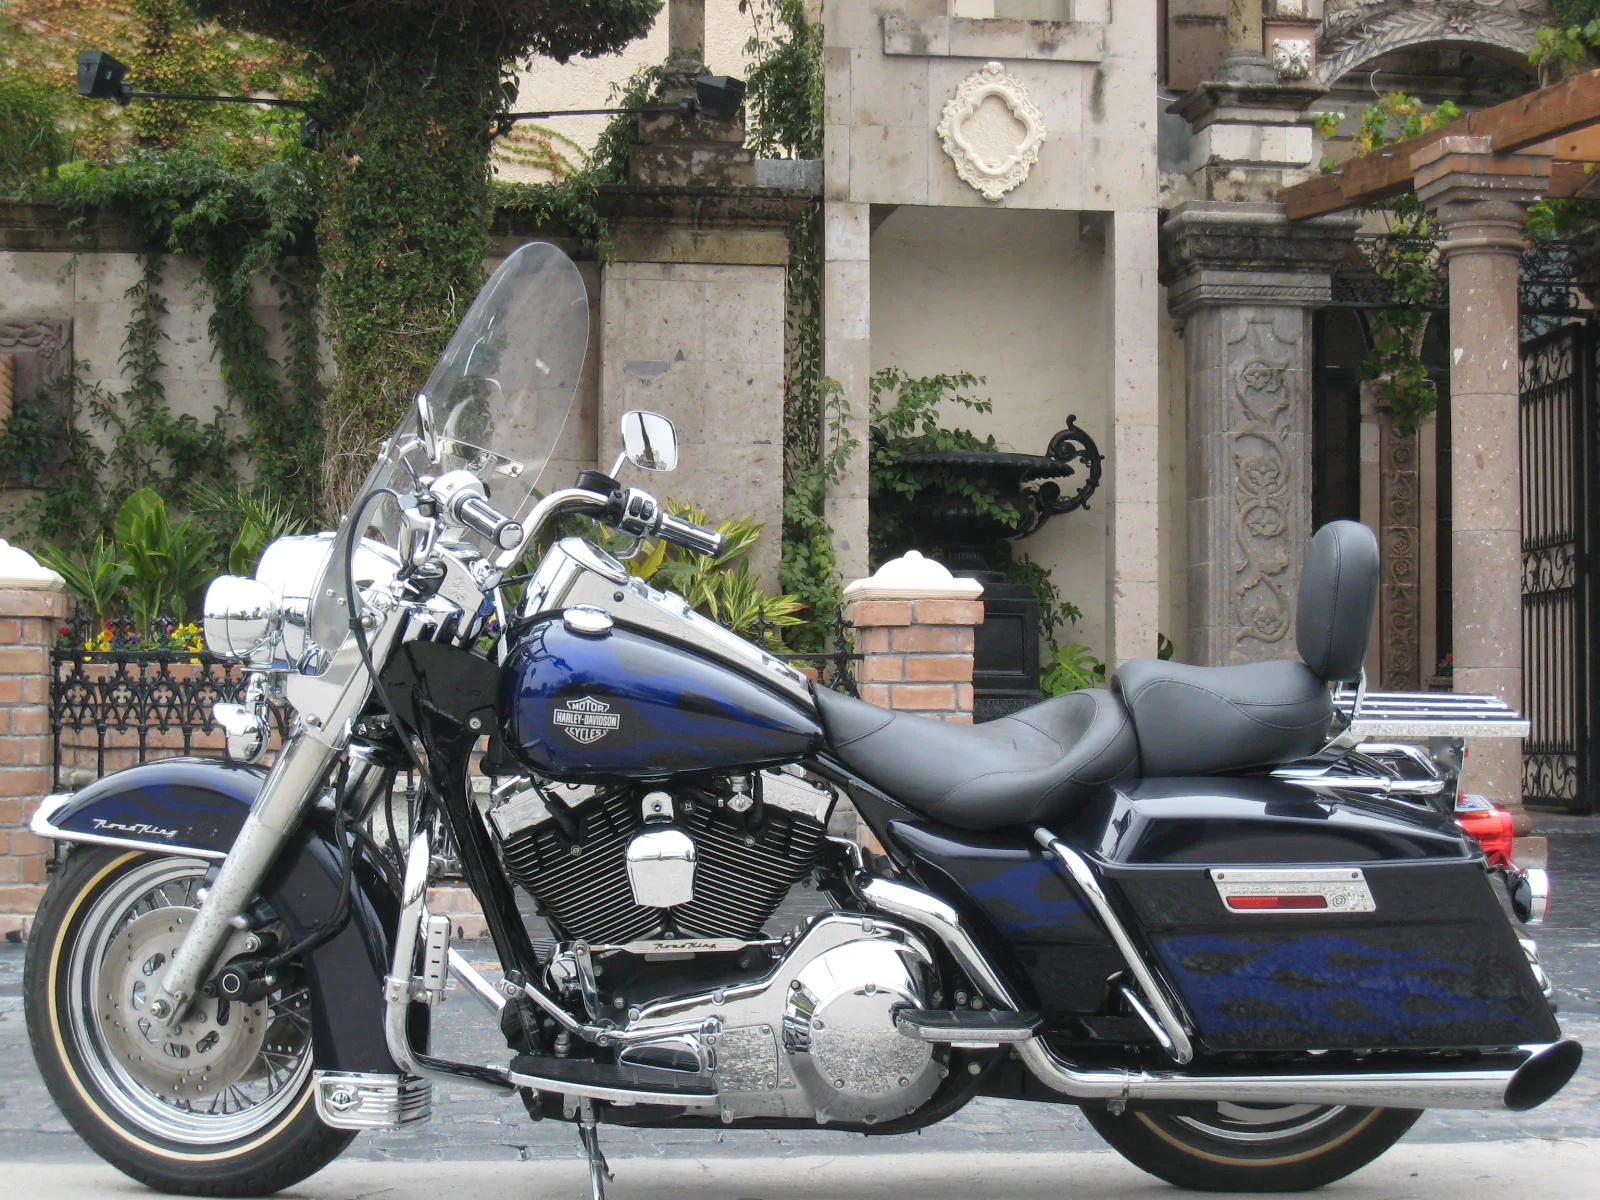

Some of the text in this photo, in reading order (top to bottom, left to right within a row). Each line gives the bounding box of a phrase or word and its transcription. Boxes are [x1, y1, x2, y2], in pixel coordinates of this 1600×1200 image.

[572, 699, 604, 712] MOTOR
[556, 711, 617, 727] HARLEY-DAVIDSON
[569, 727, 602, 741] CYCLES
